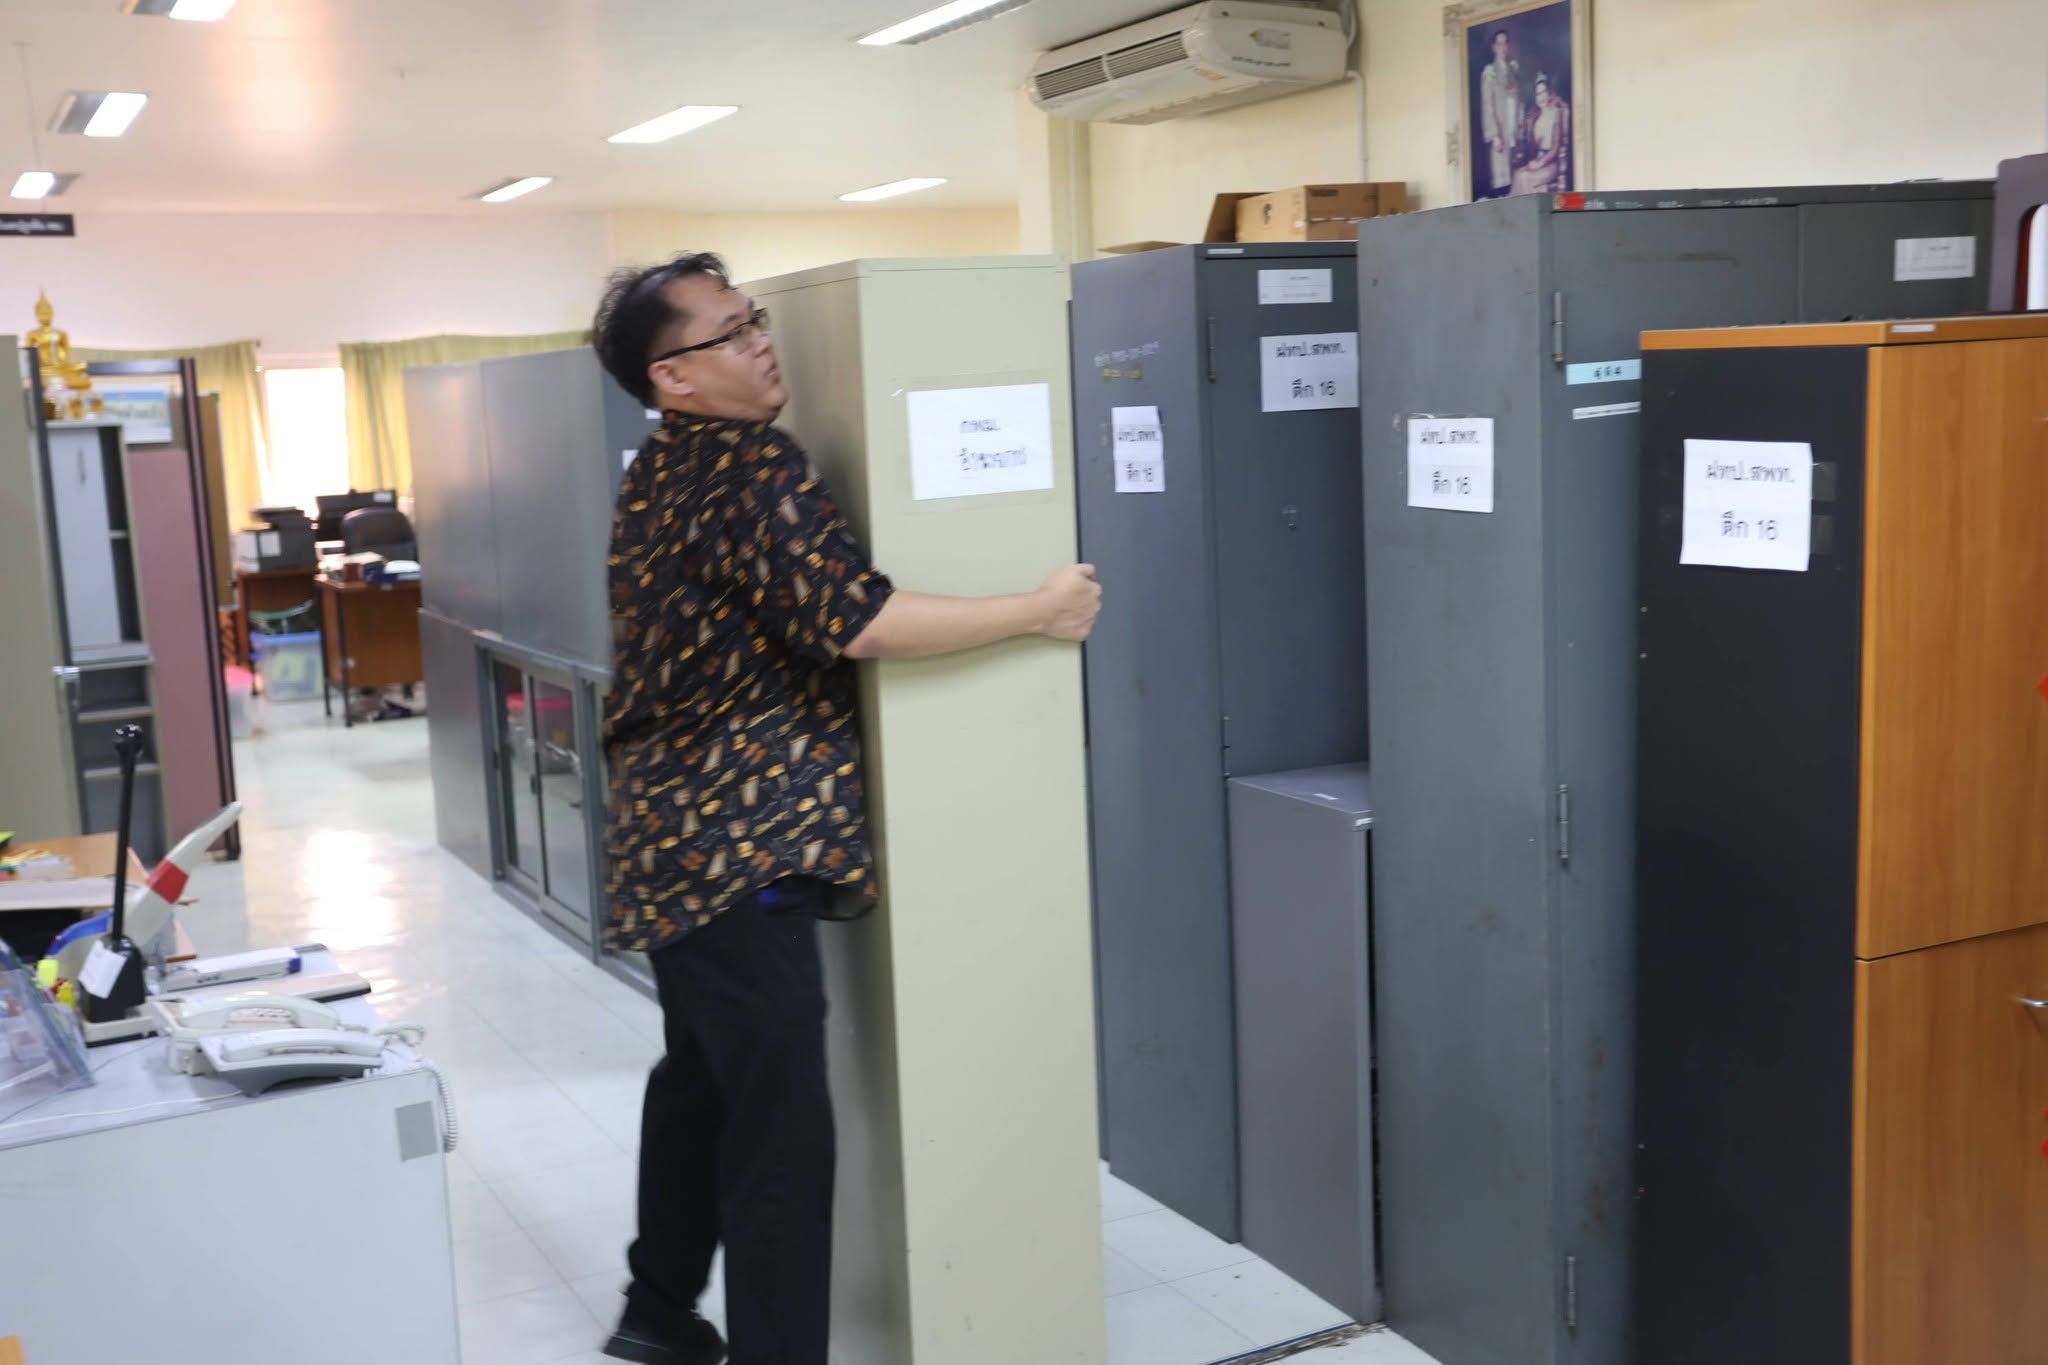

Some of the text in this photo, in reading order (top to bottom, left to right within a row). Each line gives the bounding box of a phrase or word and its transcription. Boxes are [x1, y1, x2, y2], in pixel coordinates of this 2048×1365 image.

[1319, 380, 1336, 397] 16
[1456, 476, 1471, 495] 16
[1756, 519, 1777, 541] 16
